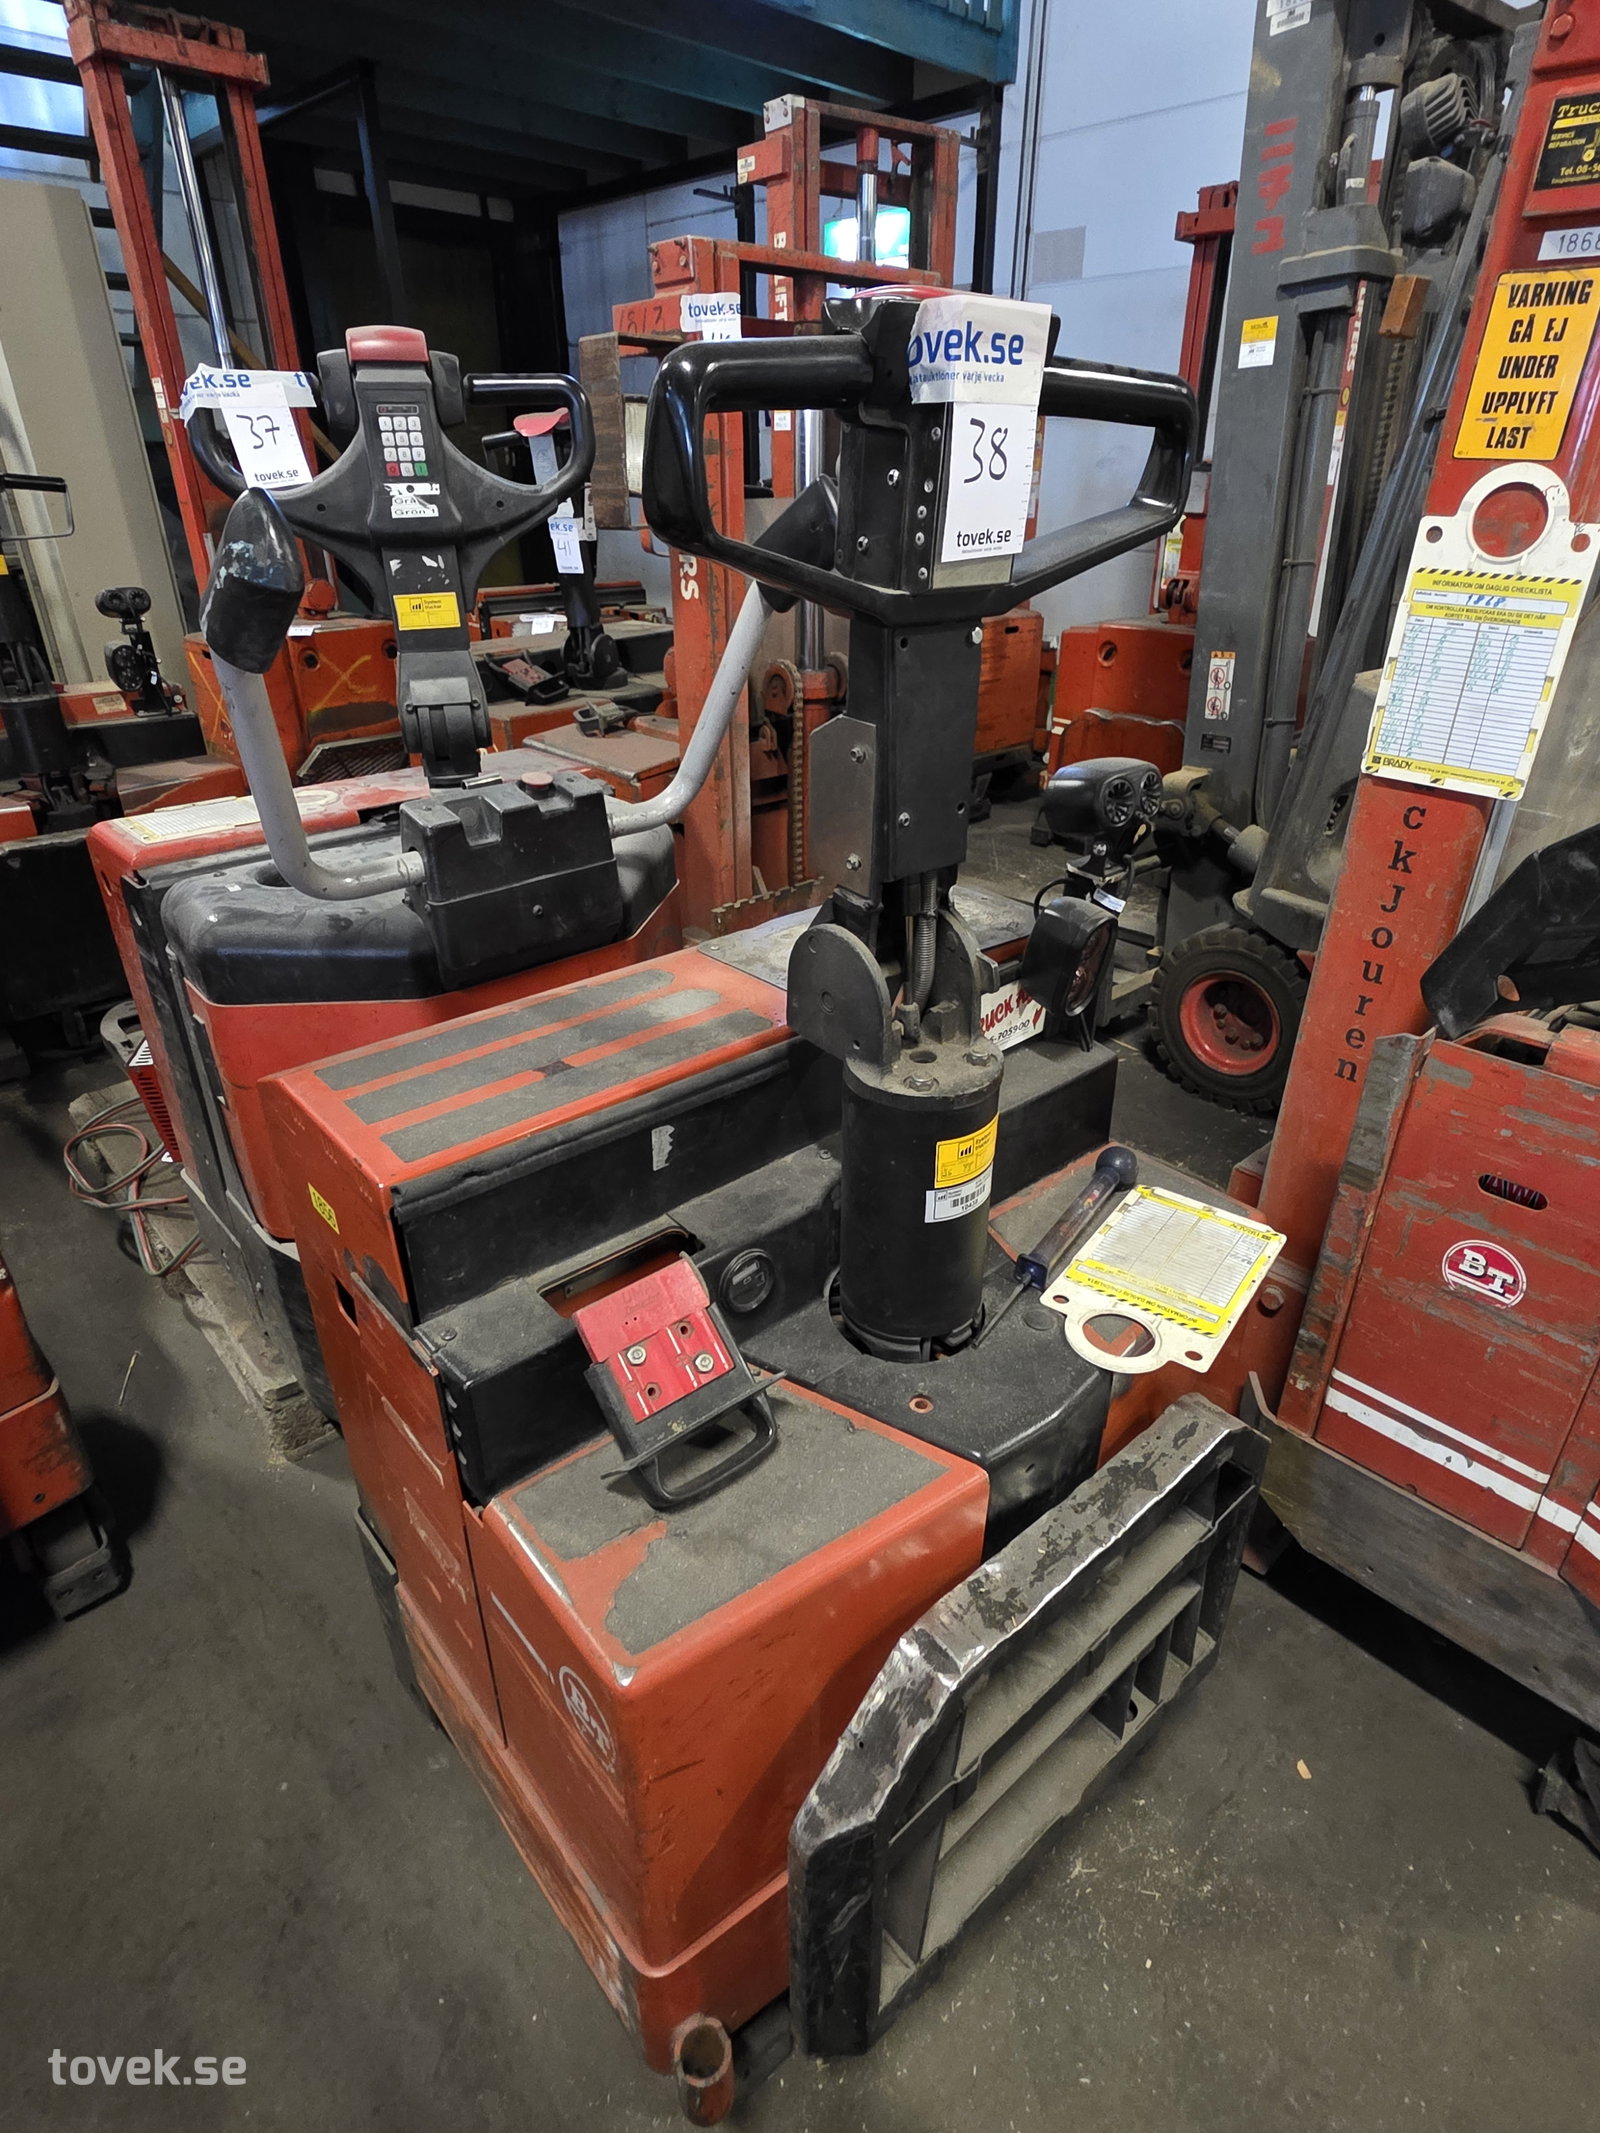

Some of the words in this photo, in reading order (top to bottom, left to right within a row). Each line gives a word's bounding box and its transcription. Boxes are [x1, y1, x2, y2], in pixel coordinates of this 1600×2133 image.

[1557, 102, 1600, 118] Truc
[1507, 279, 1594, 309] VARNING
[1508, 314, 1536, 343] GÅ
[1543, 317, 1569, 342] EJ
[1497, 354, 1559, 379] UNDER
[1481, 390, 1558, 415] UPPLYFT
[235, 414, 280, 450] 37
[1485, 425, 1532, 449] LAST
[963, 417, 1009, 484] 38
[254, 468, 299, 482] tovek.se
[956, 528, 1012, 547] tovek.se
[1432, 579, 1474, 589] INFORMATION
[1511, 586, 1553, 595] CHECKLISTA
[1382, 757, 1413, 770] BRADY
[1458, 1247, 1515, 1295] BT
